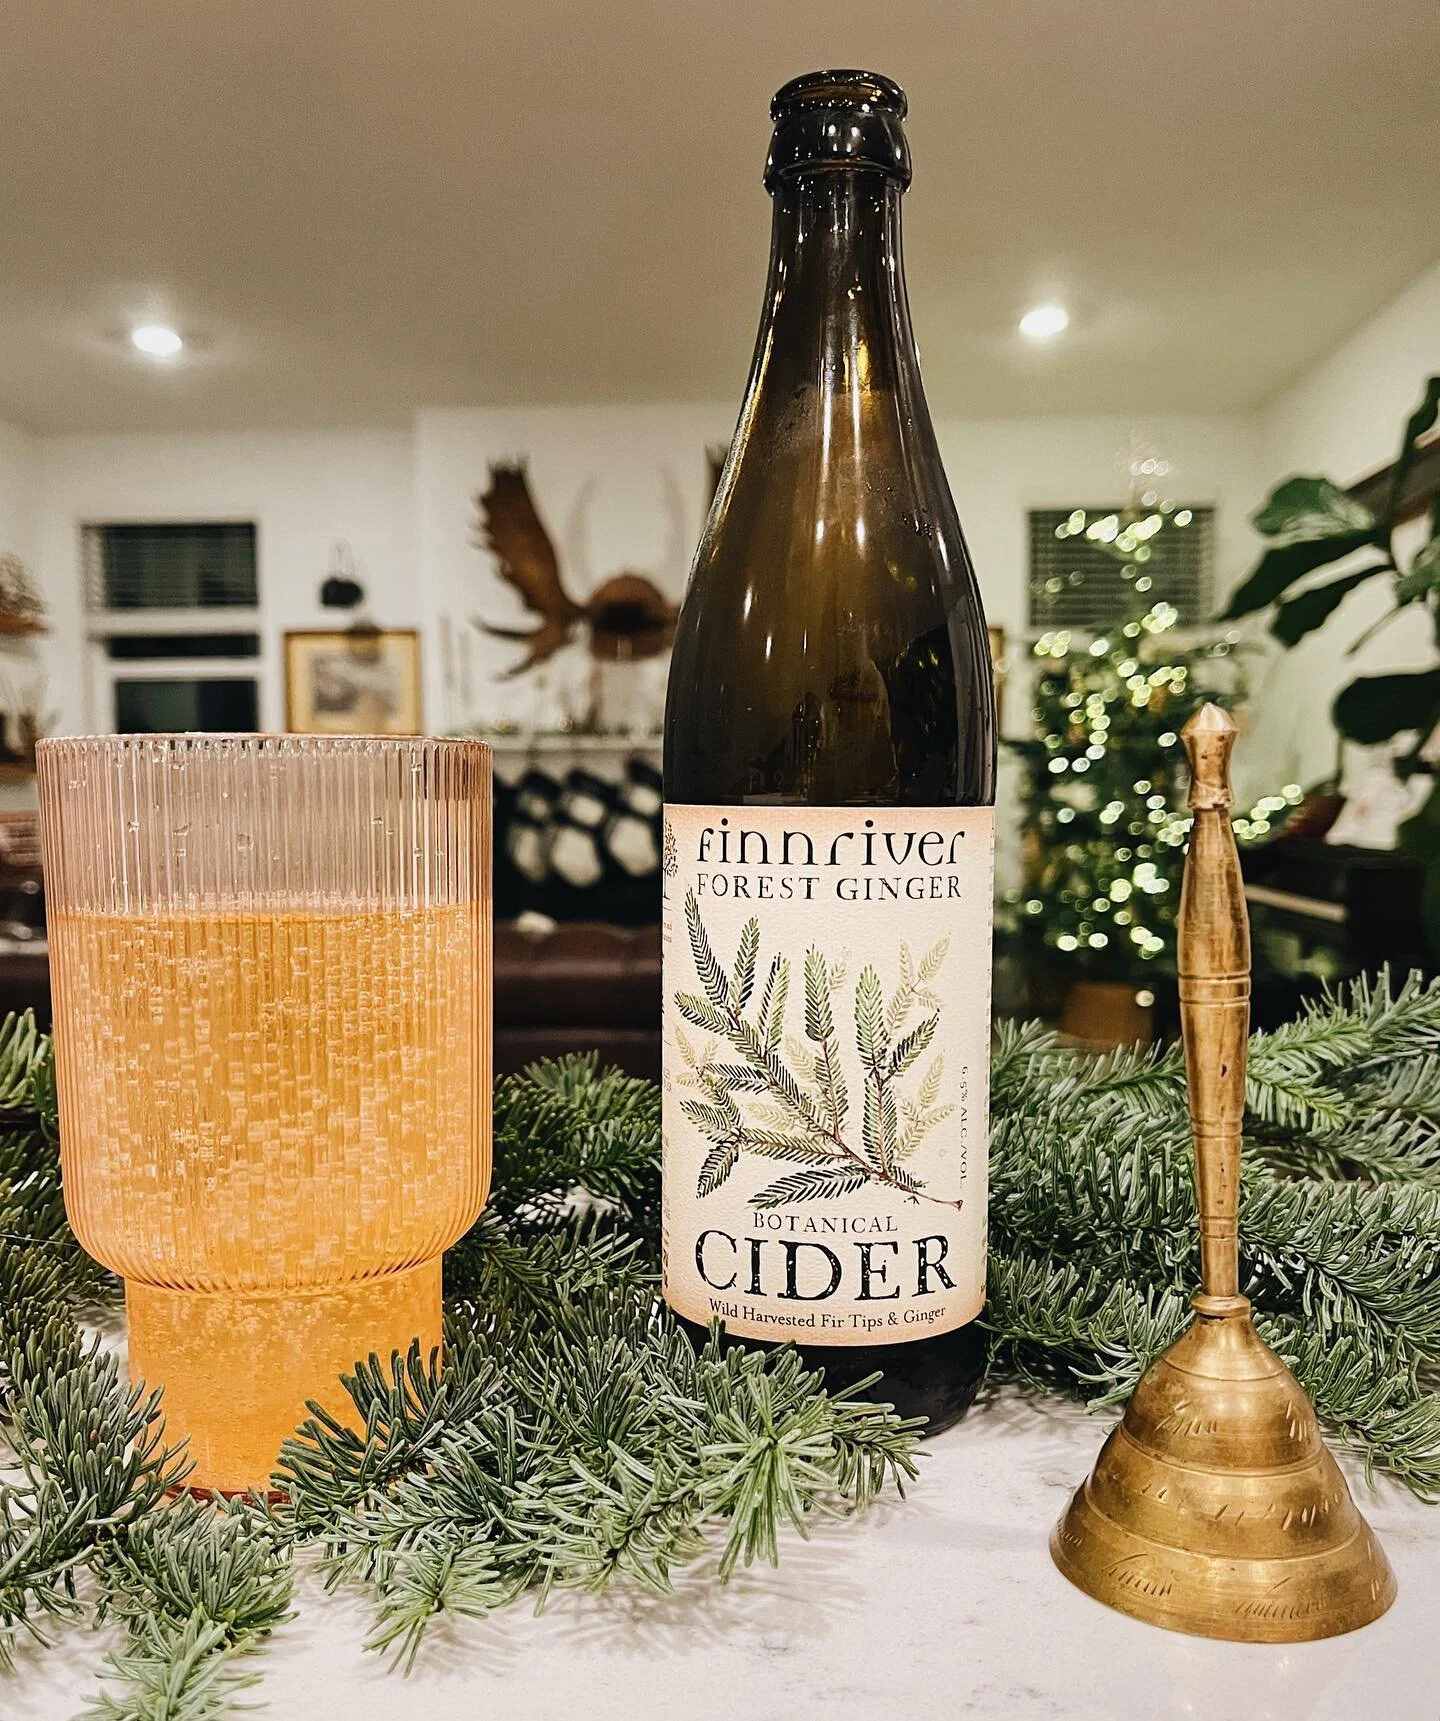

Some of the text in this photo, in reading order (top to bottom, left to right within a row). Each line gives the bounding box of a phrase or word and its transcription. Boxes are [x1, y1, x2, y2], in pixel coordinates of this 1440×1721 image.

[697, 817, 965, 866] finnriver
[697, 873, 962, 900] FOREST GINGER
[959, 1065, 969, 1102] 6.5%
[753, 1212, 898, 1234] BOTANICAL
[695, 1229, 957, 1301] CIDER
[709, 1298, 946, 1332] Wild Harvested Fir Tips & Ginger
